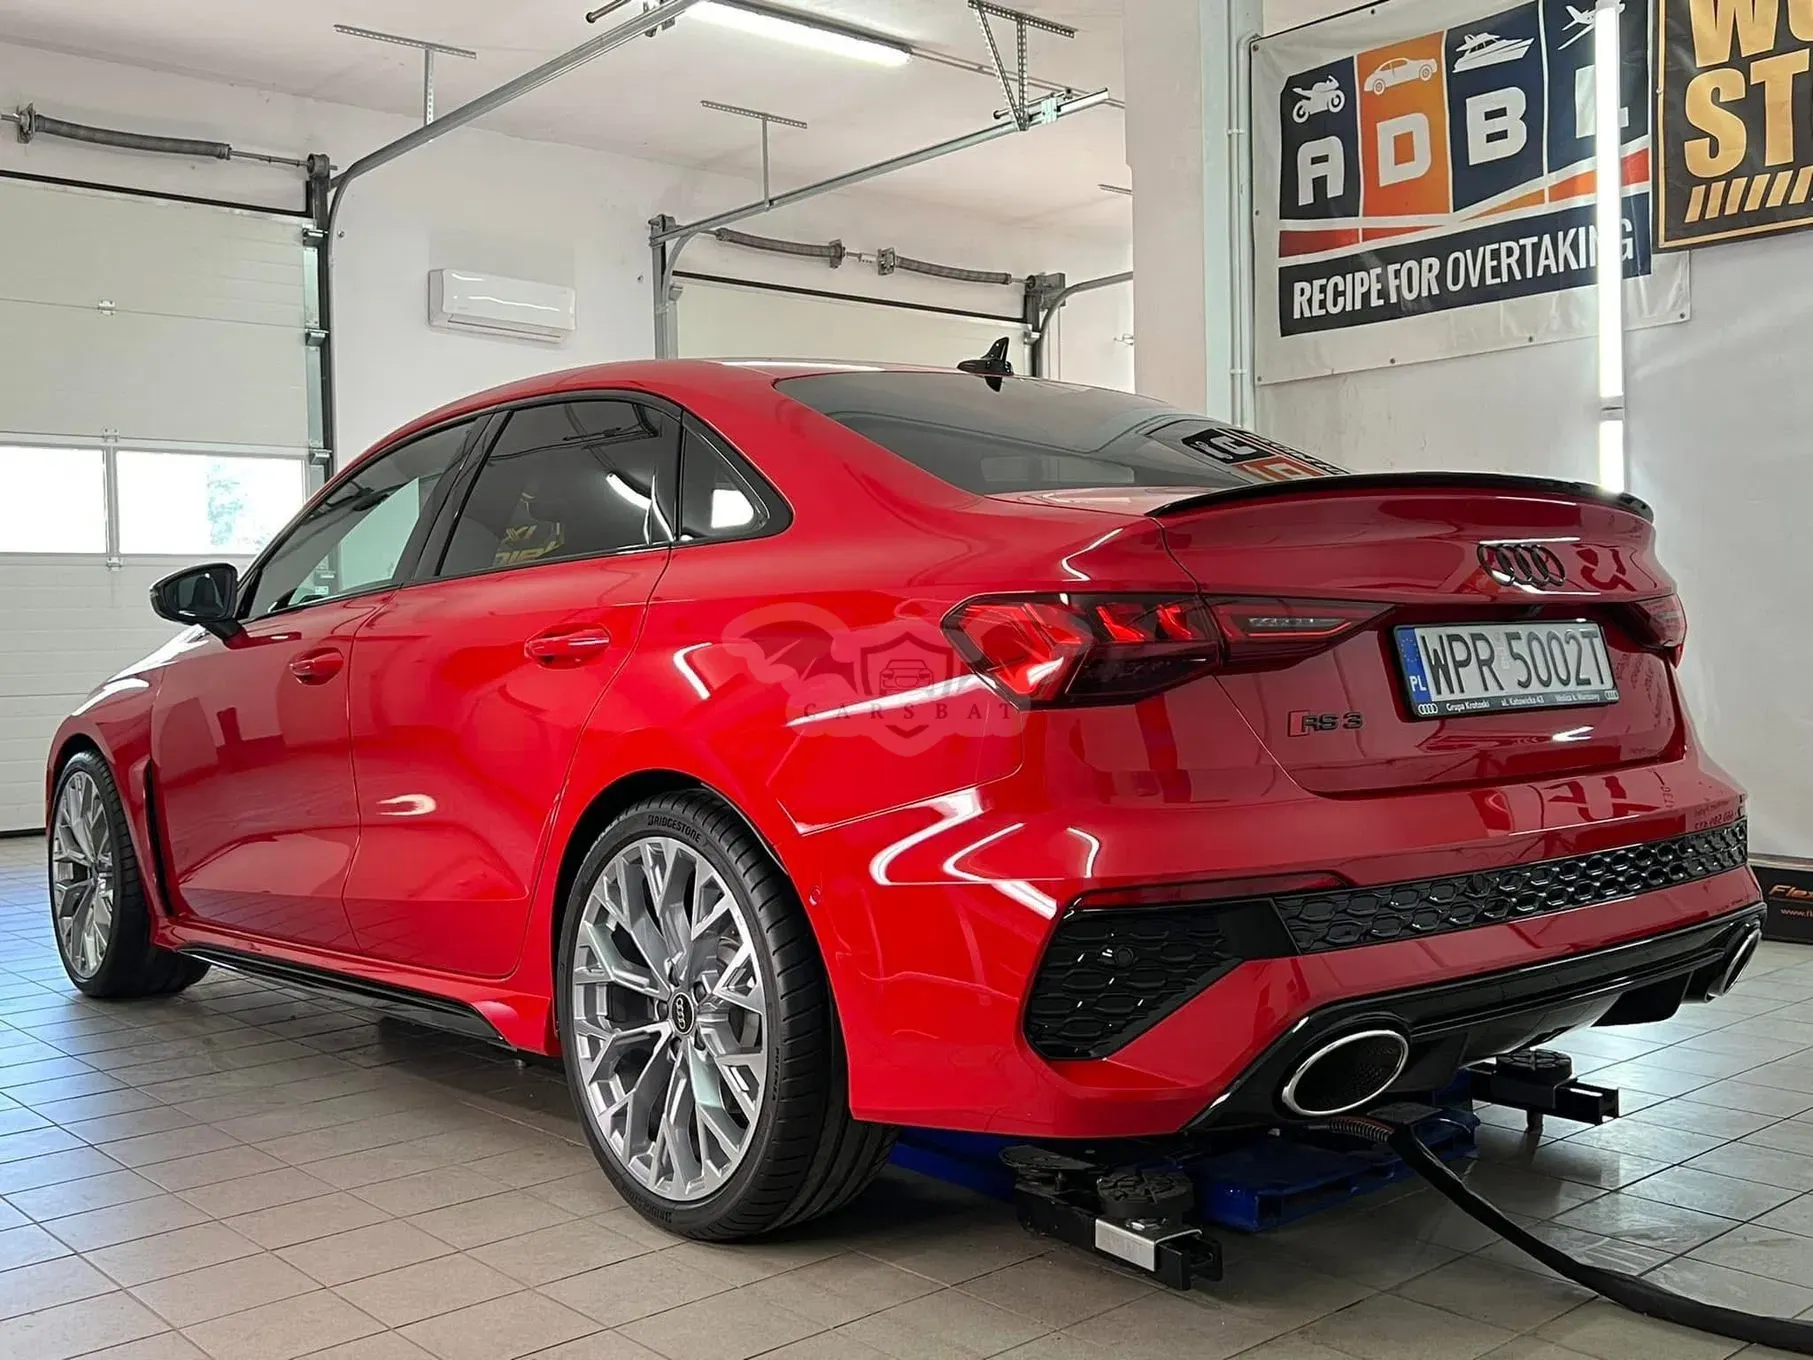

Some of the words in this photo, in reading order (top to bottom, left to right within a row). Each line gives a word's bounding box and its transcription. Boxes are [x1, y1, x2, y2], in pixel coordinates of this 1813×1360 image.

[1689, 0, 1813, 68] W
[1293, 266, 1385, 319] RECIPE
[1387, 256, 1441, 303] FOR
[1409, 675, 1428, 692] PL
[1420, 632, 1504, 695] WPR
[1504, 631, 1604, 689] 5002T
[647, 814, 702, 843] BRIDGESTONE
